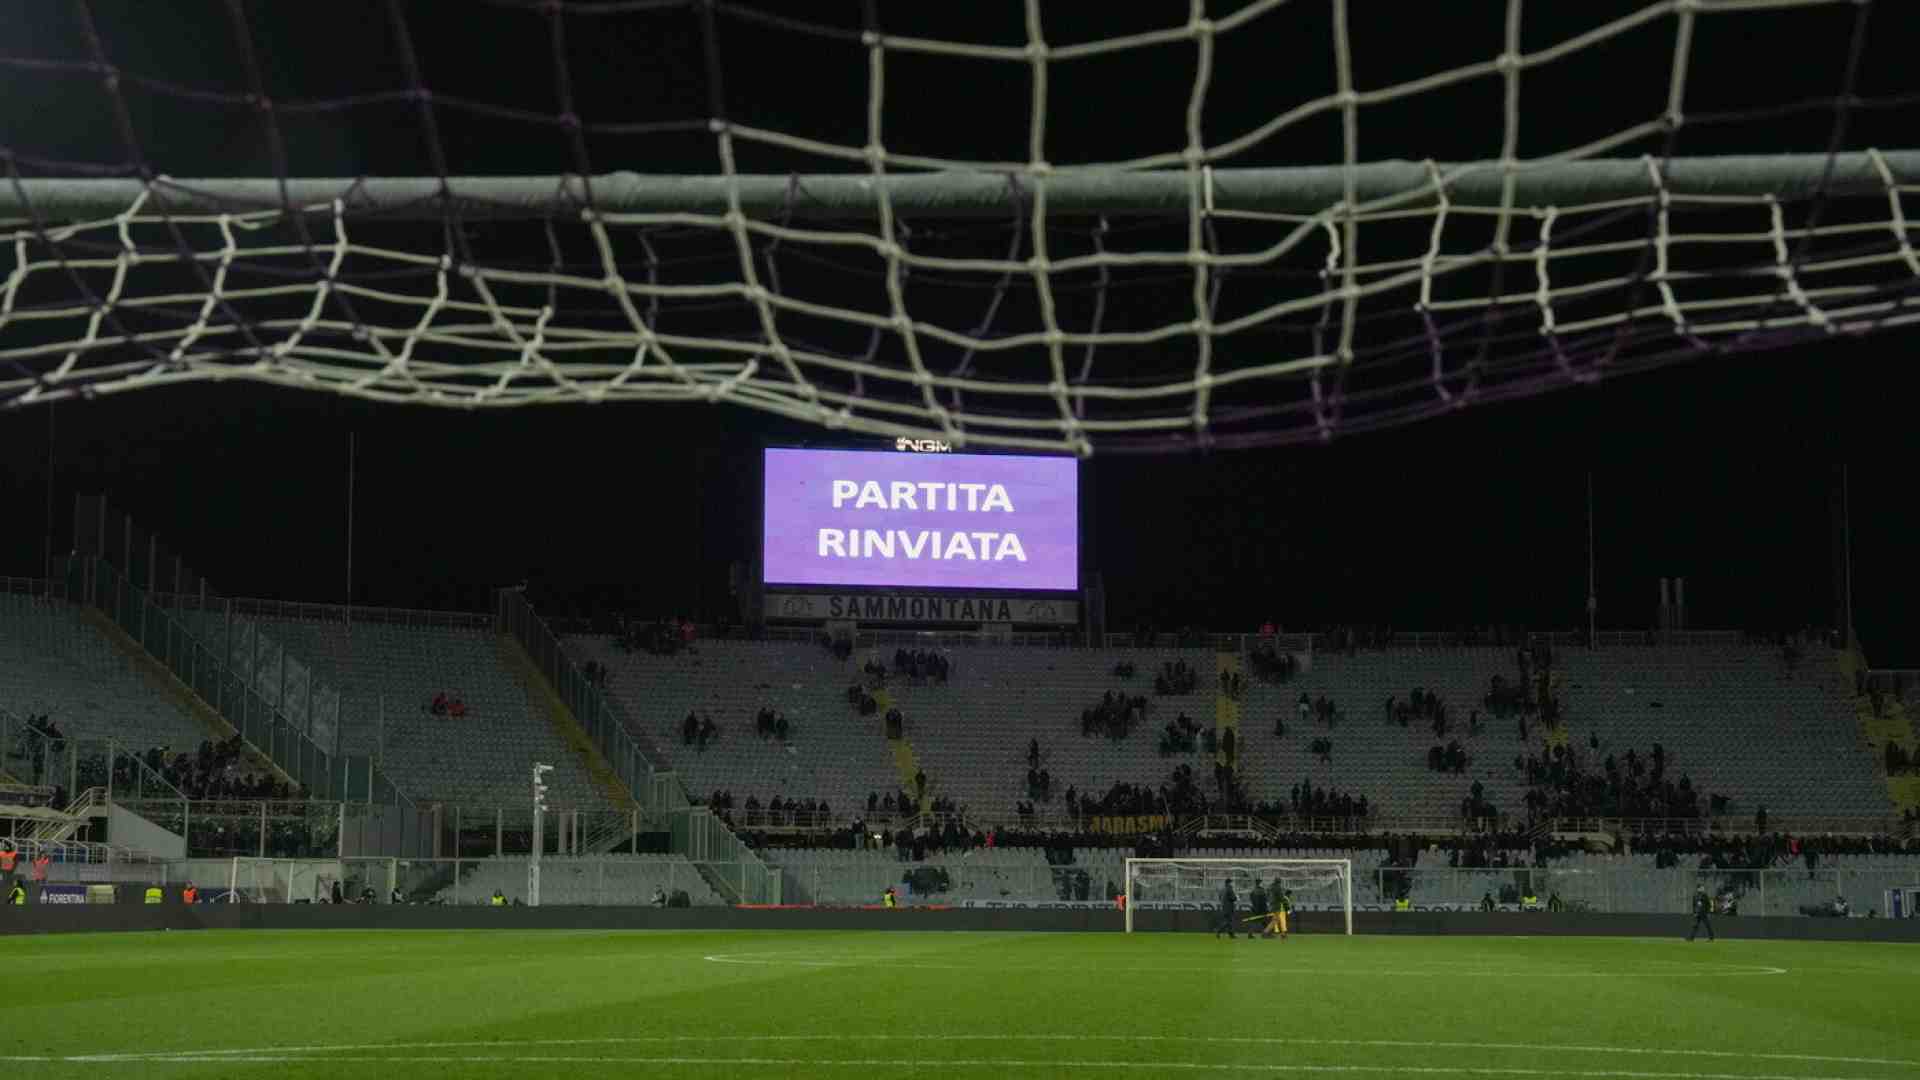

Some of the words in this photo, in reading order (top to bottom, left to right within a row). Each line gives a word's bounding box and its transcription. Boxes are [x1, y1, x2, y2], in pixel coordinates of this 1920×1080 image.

[832, 480, 1014, 512] PARTITA
[818, 528, 1027, 561] RINVIATA
[829, 596, 1012, 621] SAMMONTANA
